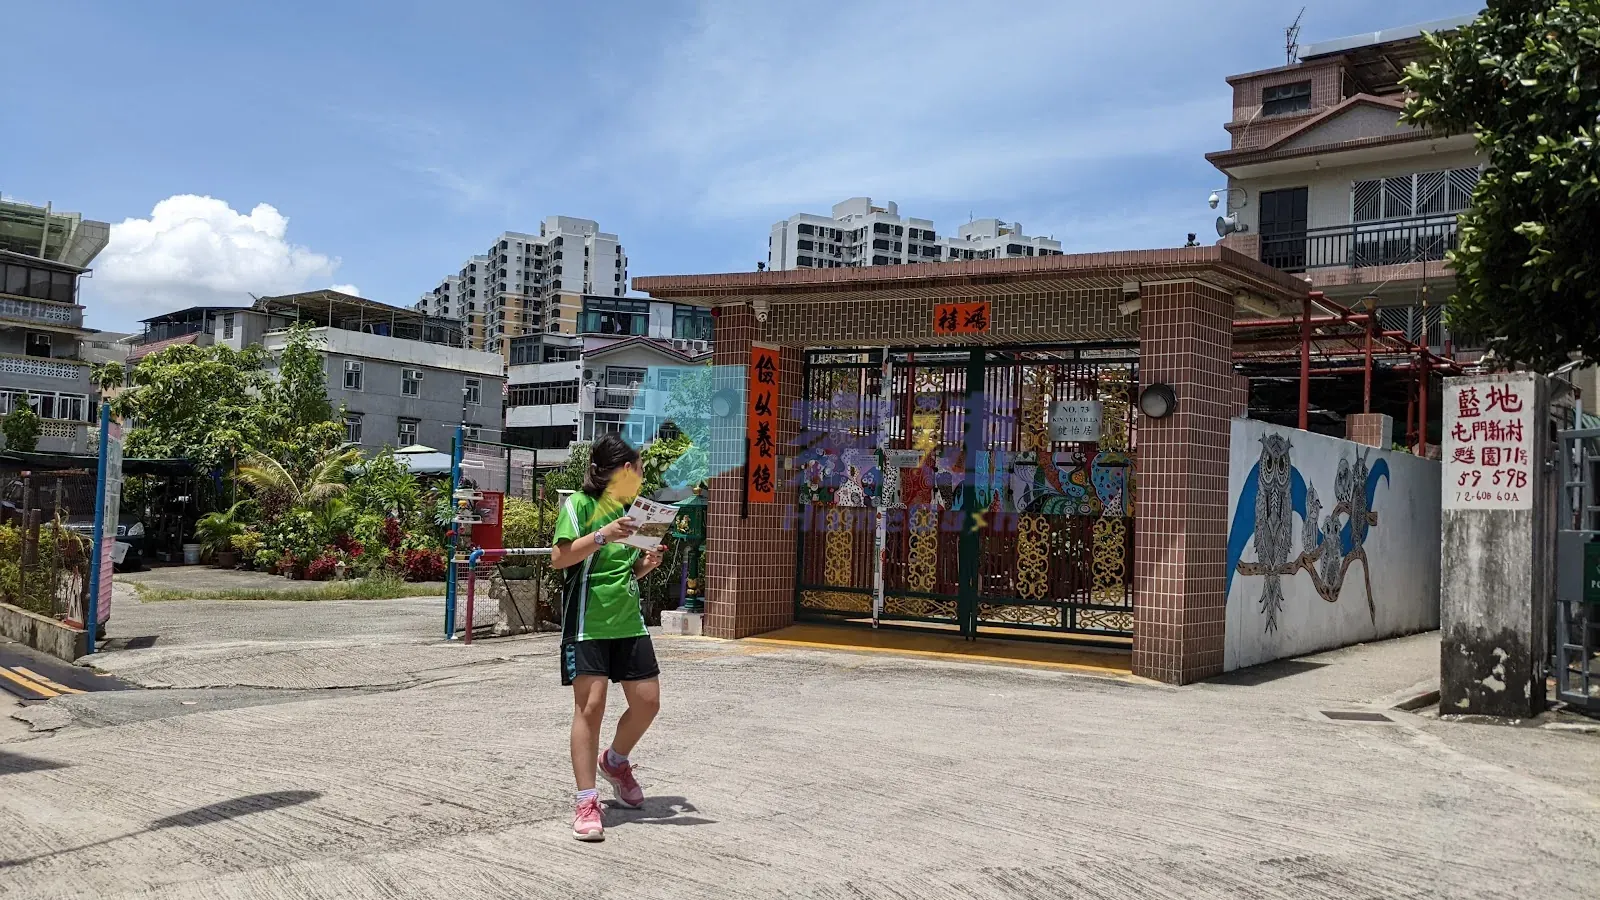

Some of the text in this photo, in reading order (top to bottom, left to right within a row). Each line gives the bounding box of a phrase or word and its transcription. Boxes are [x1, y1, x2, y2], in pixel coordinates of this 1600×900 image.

[1458, 383, 1523, 418] 藍地
[1057, 425, 1092, 436] 健怡居
[1451, 418, 1524, 443] 屯門新村
[1457, 468, 1528, 488] 59 59B
[1496, 490, 1520, 502] 60A
